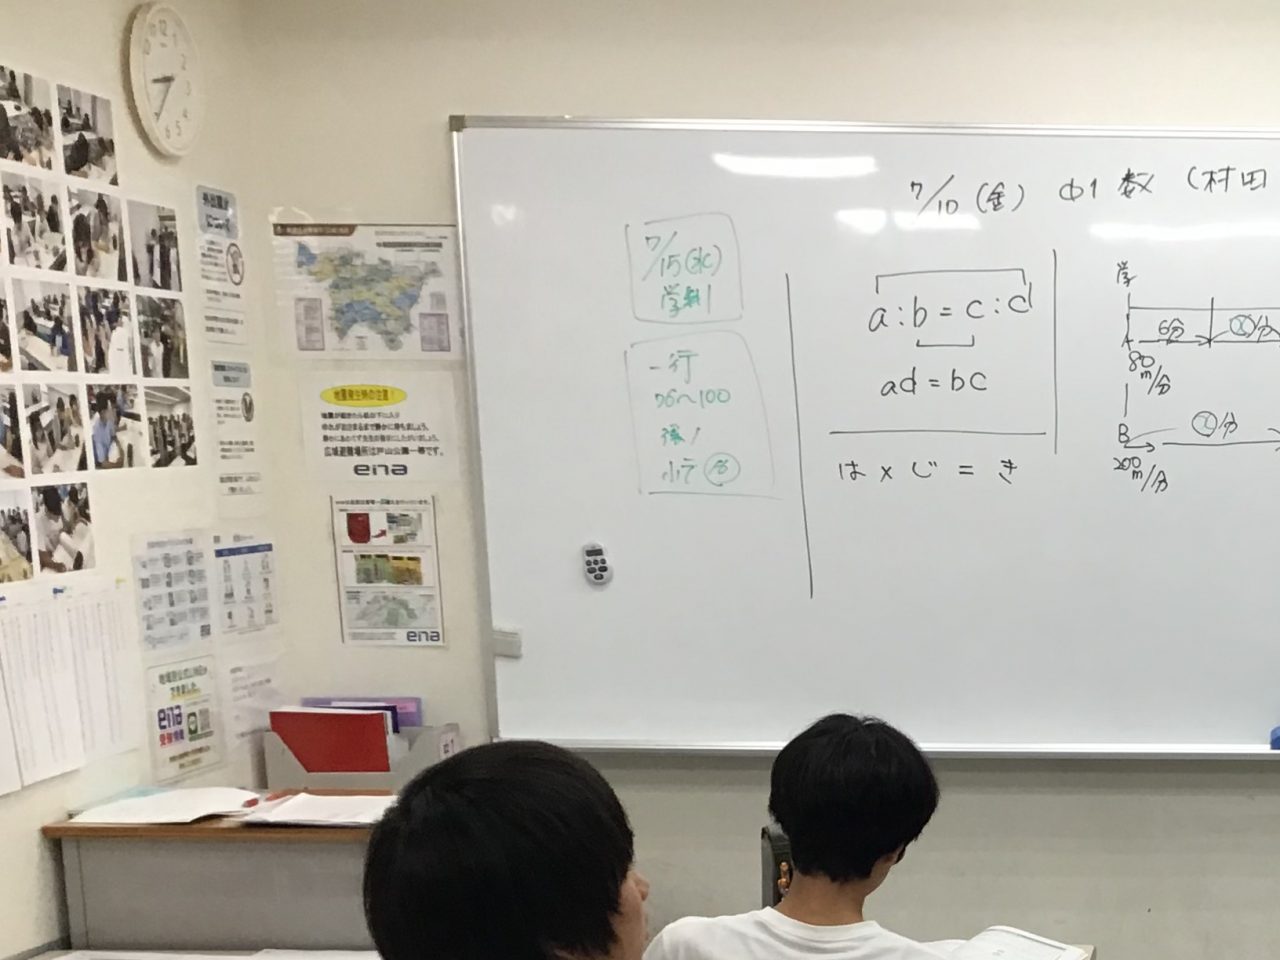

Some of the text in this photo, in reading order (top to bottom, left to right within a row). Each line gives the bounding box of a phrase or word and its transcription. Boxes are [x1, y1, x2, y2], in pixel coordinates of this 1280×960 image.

[1118, 422, 1131, 444] B
[353, 463, 408, 476] ena
[406, 630, 441, 643] ena
[157, 704, 183, 730] ena
